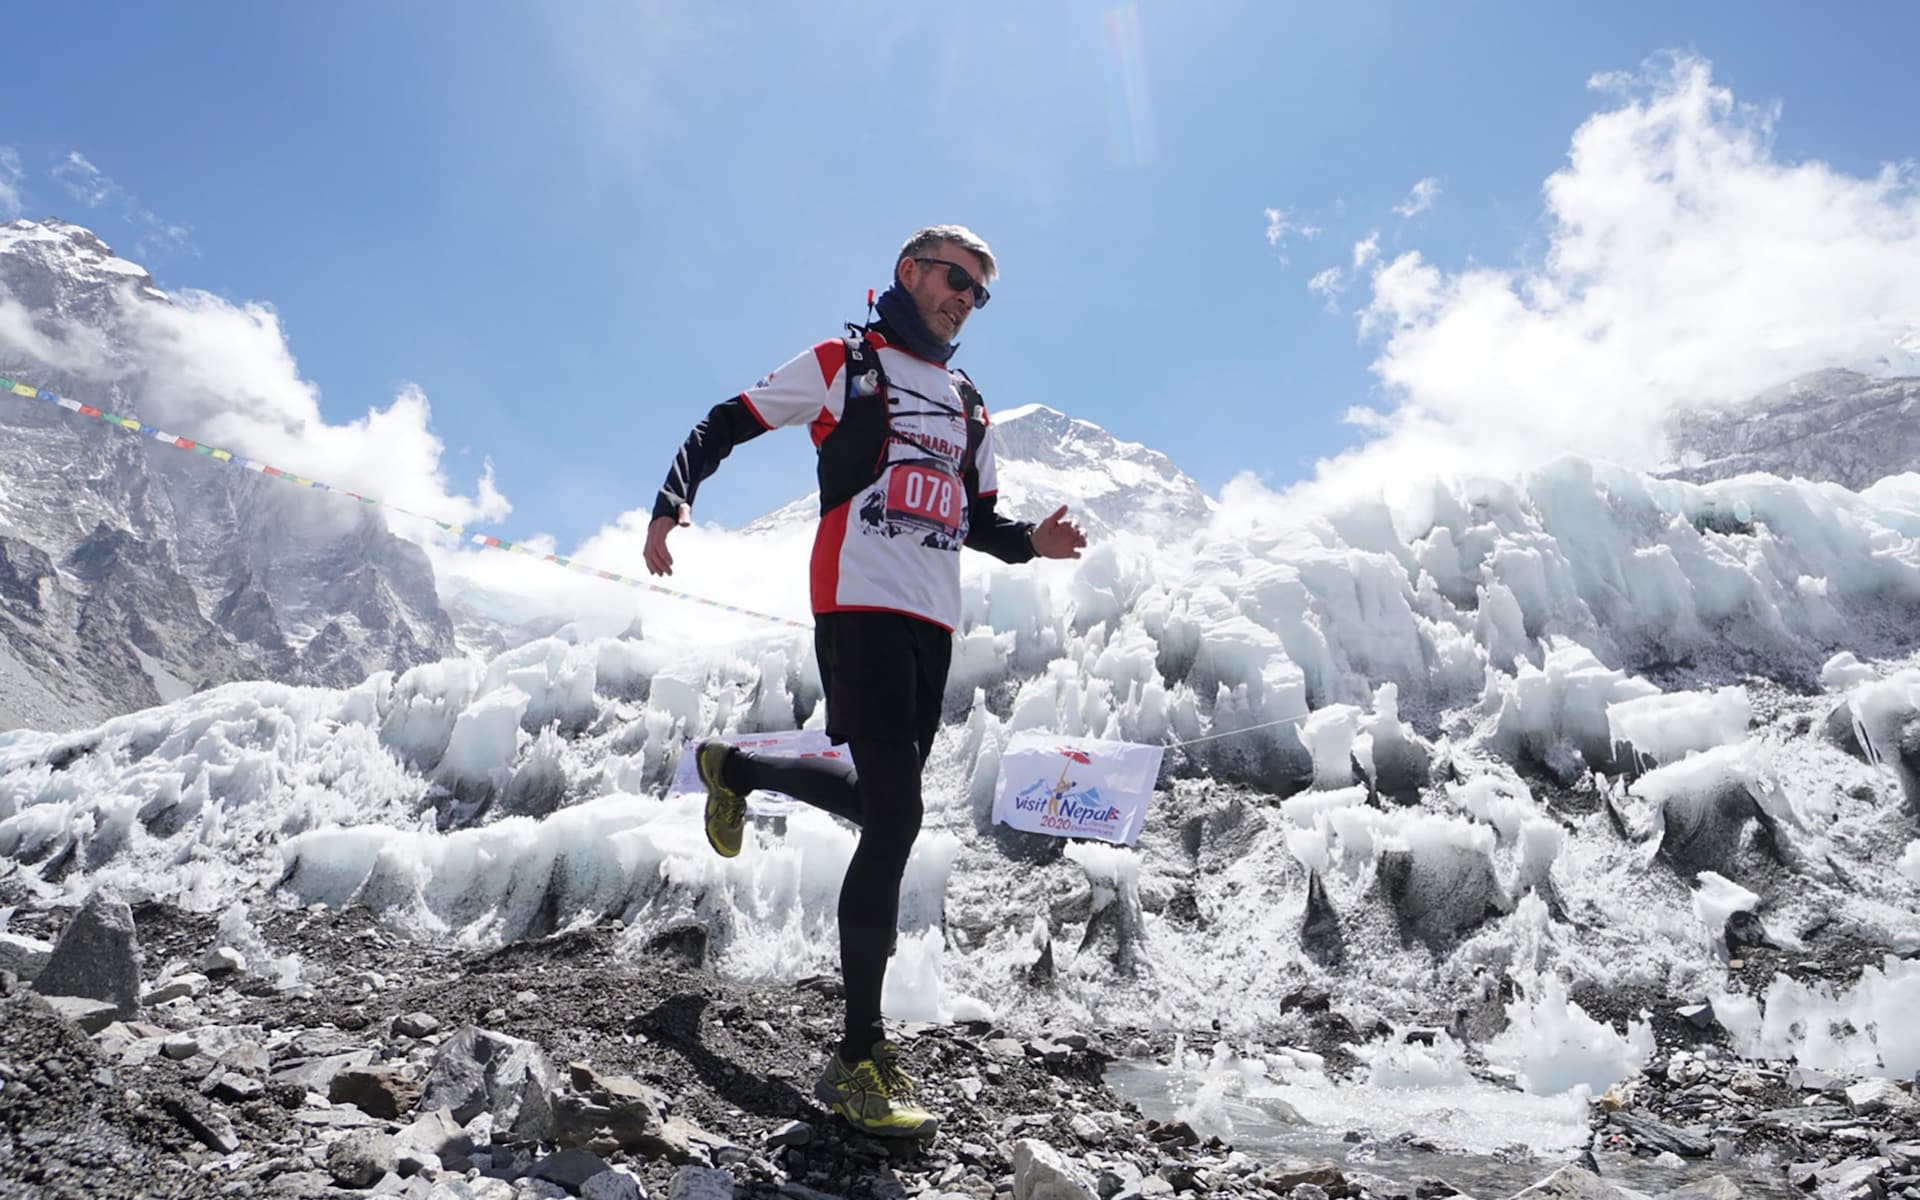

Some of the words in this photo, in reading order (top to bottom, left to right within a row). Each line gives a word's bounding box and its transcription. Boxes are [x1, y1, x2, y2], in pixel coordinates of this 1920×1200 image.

[905, 471, 952, 518] 078
[1040, 815, 1071, 830] 2020
[1059, 799, 1113, 824] Nepal
